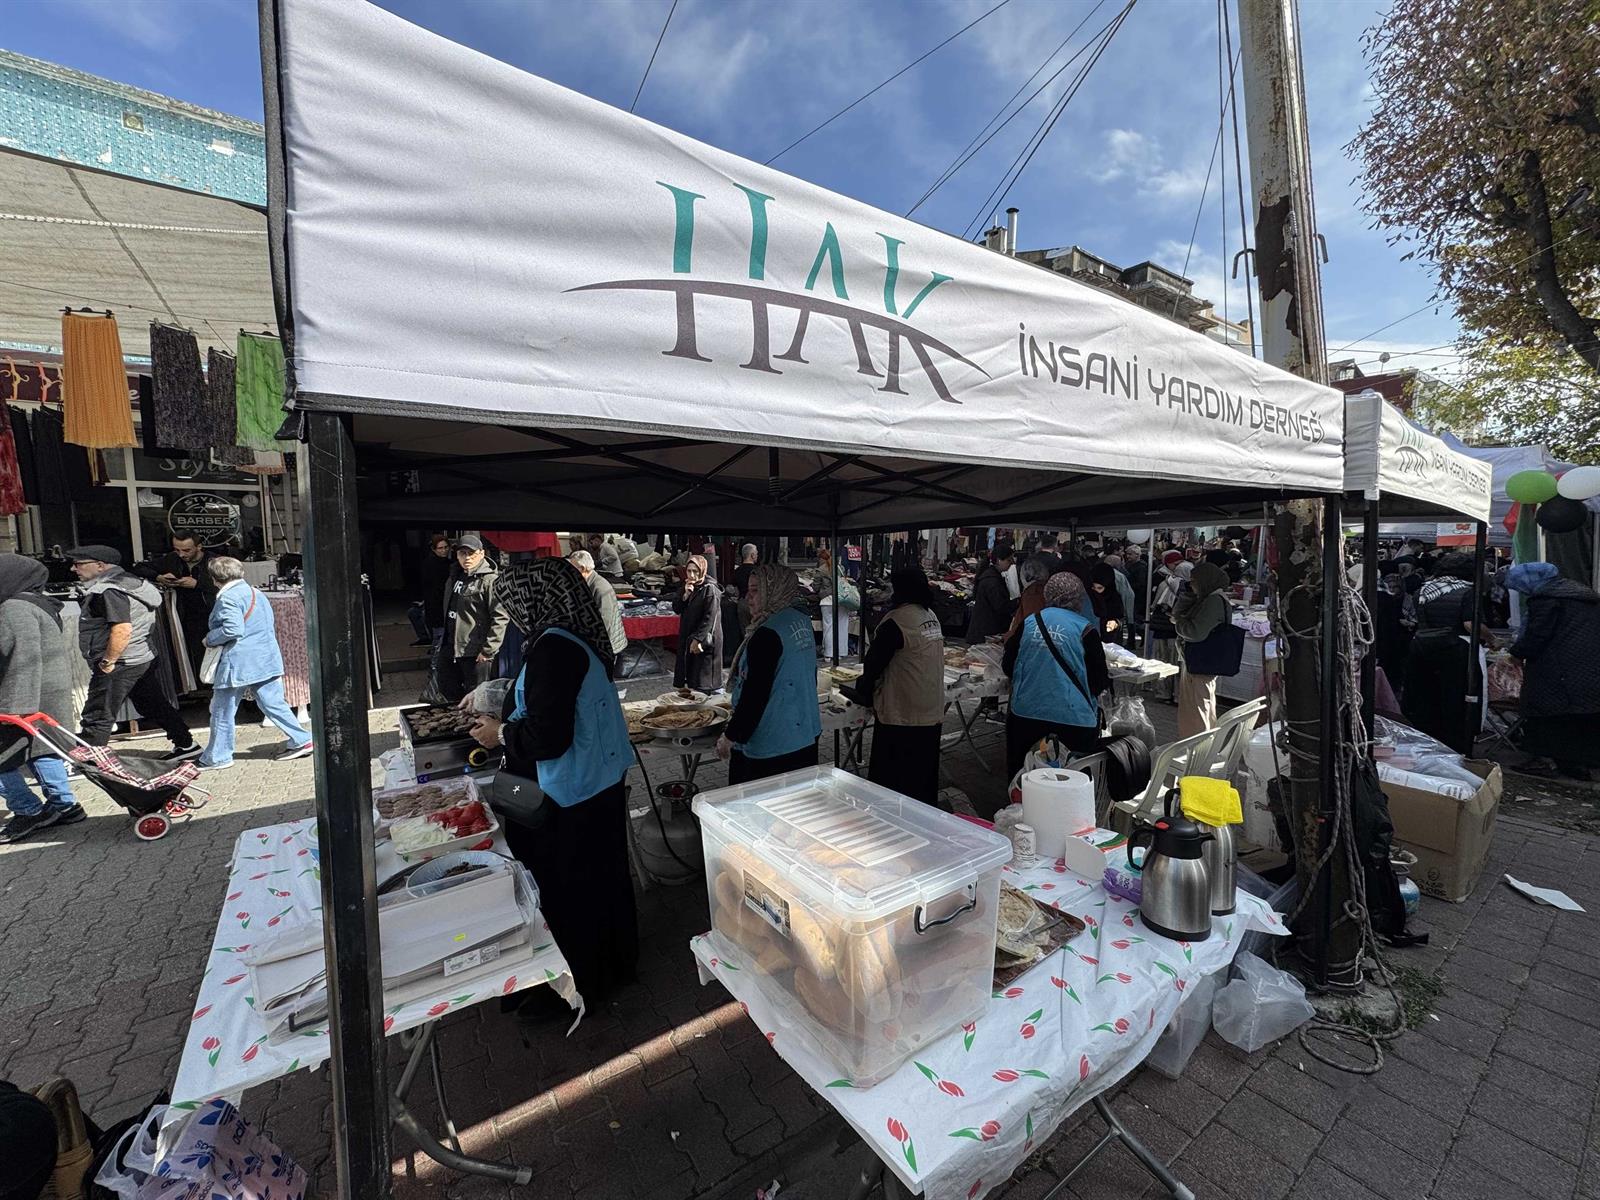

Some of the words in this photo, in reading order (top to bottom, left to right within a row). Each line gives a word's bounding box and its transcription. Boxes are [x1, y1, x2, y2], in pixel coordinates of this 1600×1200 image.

[1018, 322, 1139, 401] İNSANİ
[1147, 367, 1243, 426] YARDIM
[177, 516, 231, 525] BARBER
